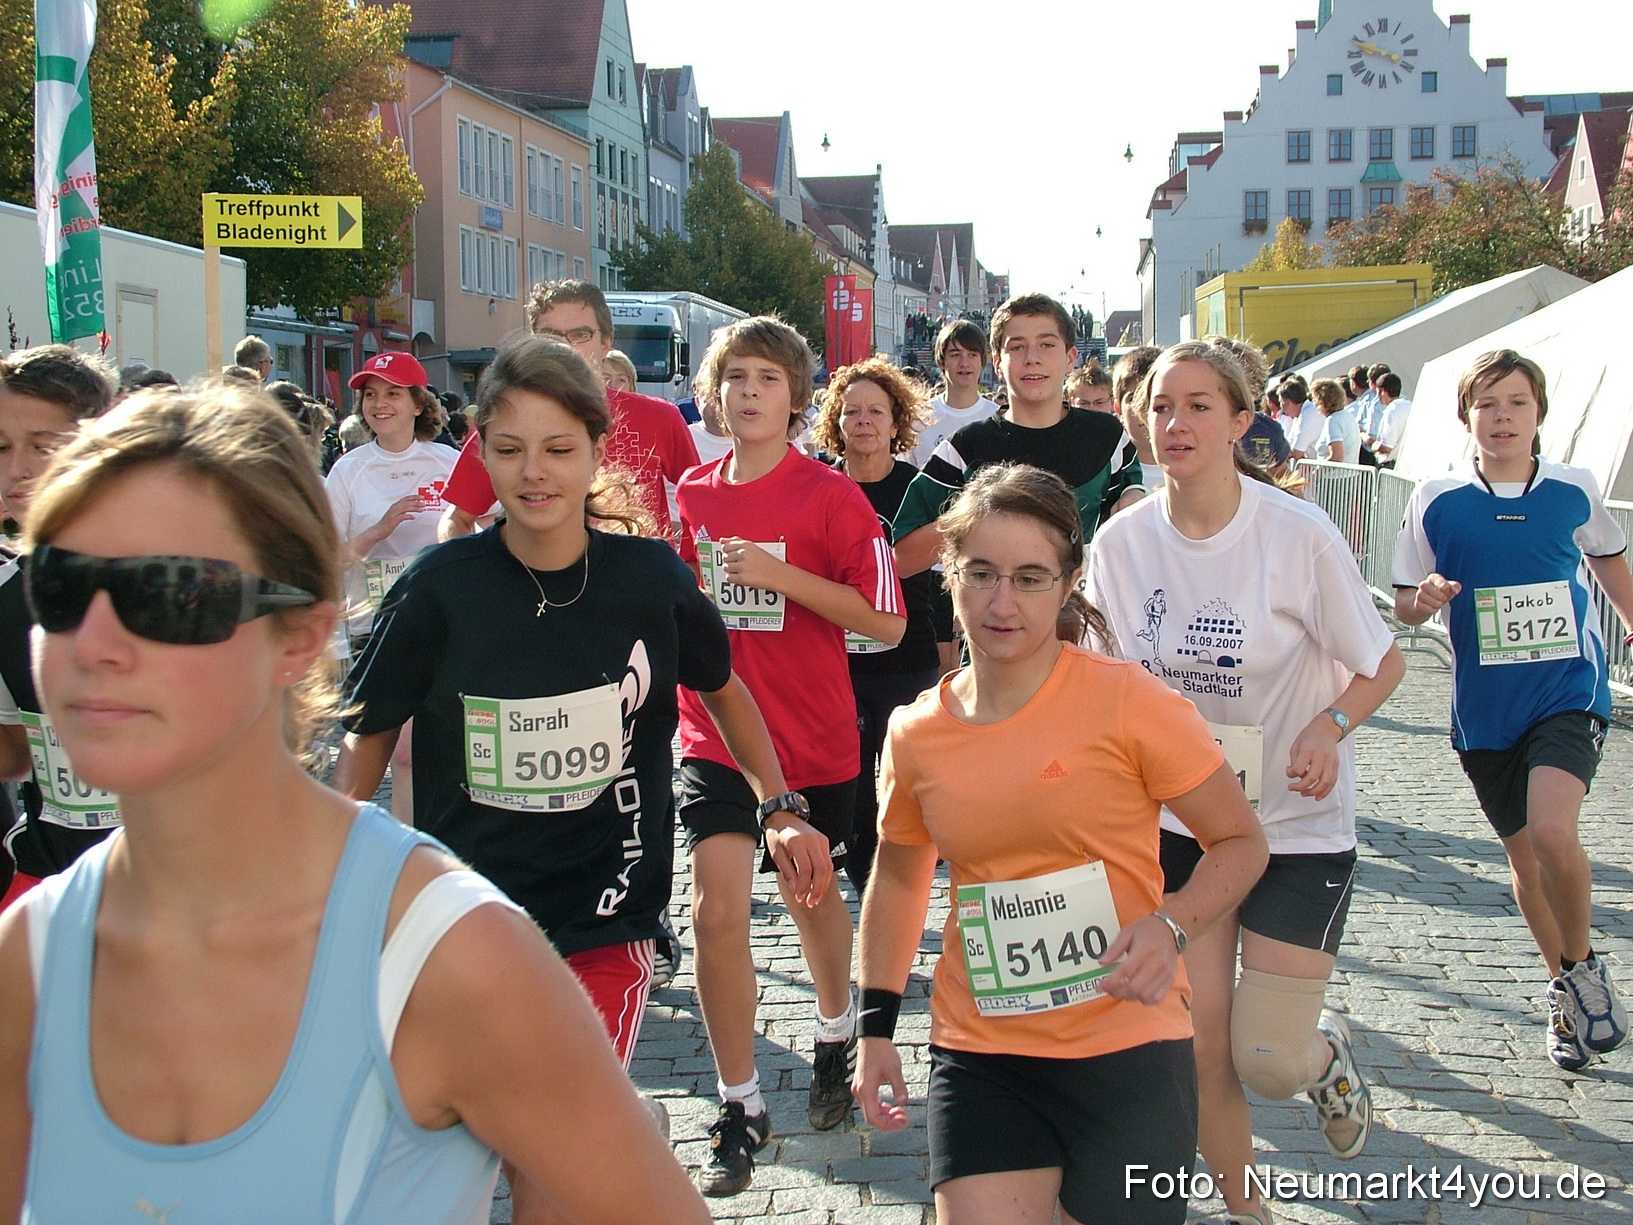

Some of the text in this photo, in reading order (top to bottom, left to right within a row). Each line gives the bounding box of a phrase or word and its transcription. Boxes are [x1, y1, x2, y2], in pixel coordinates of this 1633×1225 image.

[215, 199, 320, 220] Treffpunkt
[217, 223, 327, 244] Bladenight
[721, 582, 778, 606] 5015
[1503, 592, 1554, 613] Jakob
[1507, 616, 1569, 642] 5172
[1184, 634, 1244, 649] 16.09.2007
[1541, 645, 1578, 656] PFLEIDERER
[1162, 667, 1243, 686] Neumarkter
[1183, 680, 1243, 698] Stadtlauf
[509, 707, 569, 732] Sarah
[473, 743, 492, 759] Sc
[515, 741, 611, 781] 5099
[991, 892, 1067, 921] Melanie
[967, 938, 984, 956] Sc
[1006, 925, 1109, 978] 5140
[977, 994, 1032, 1011] BOCK
